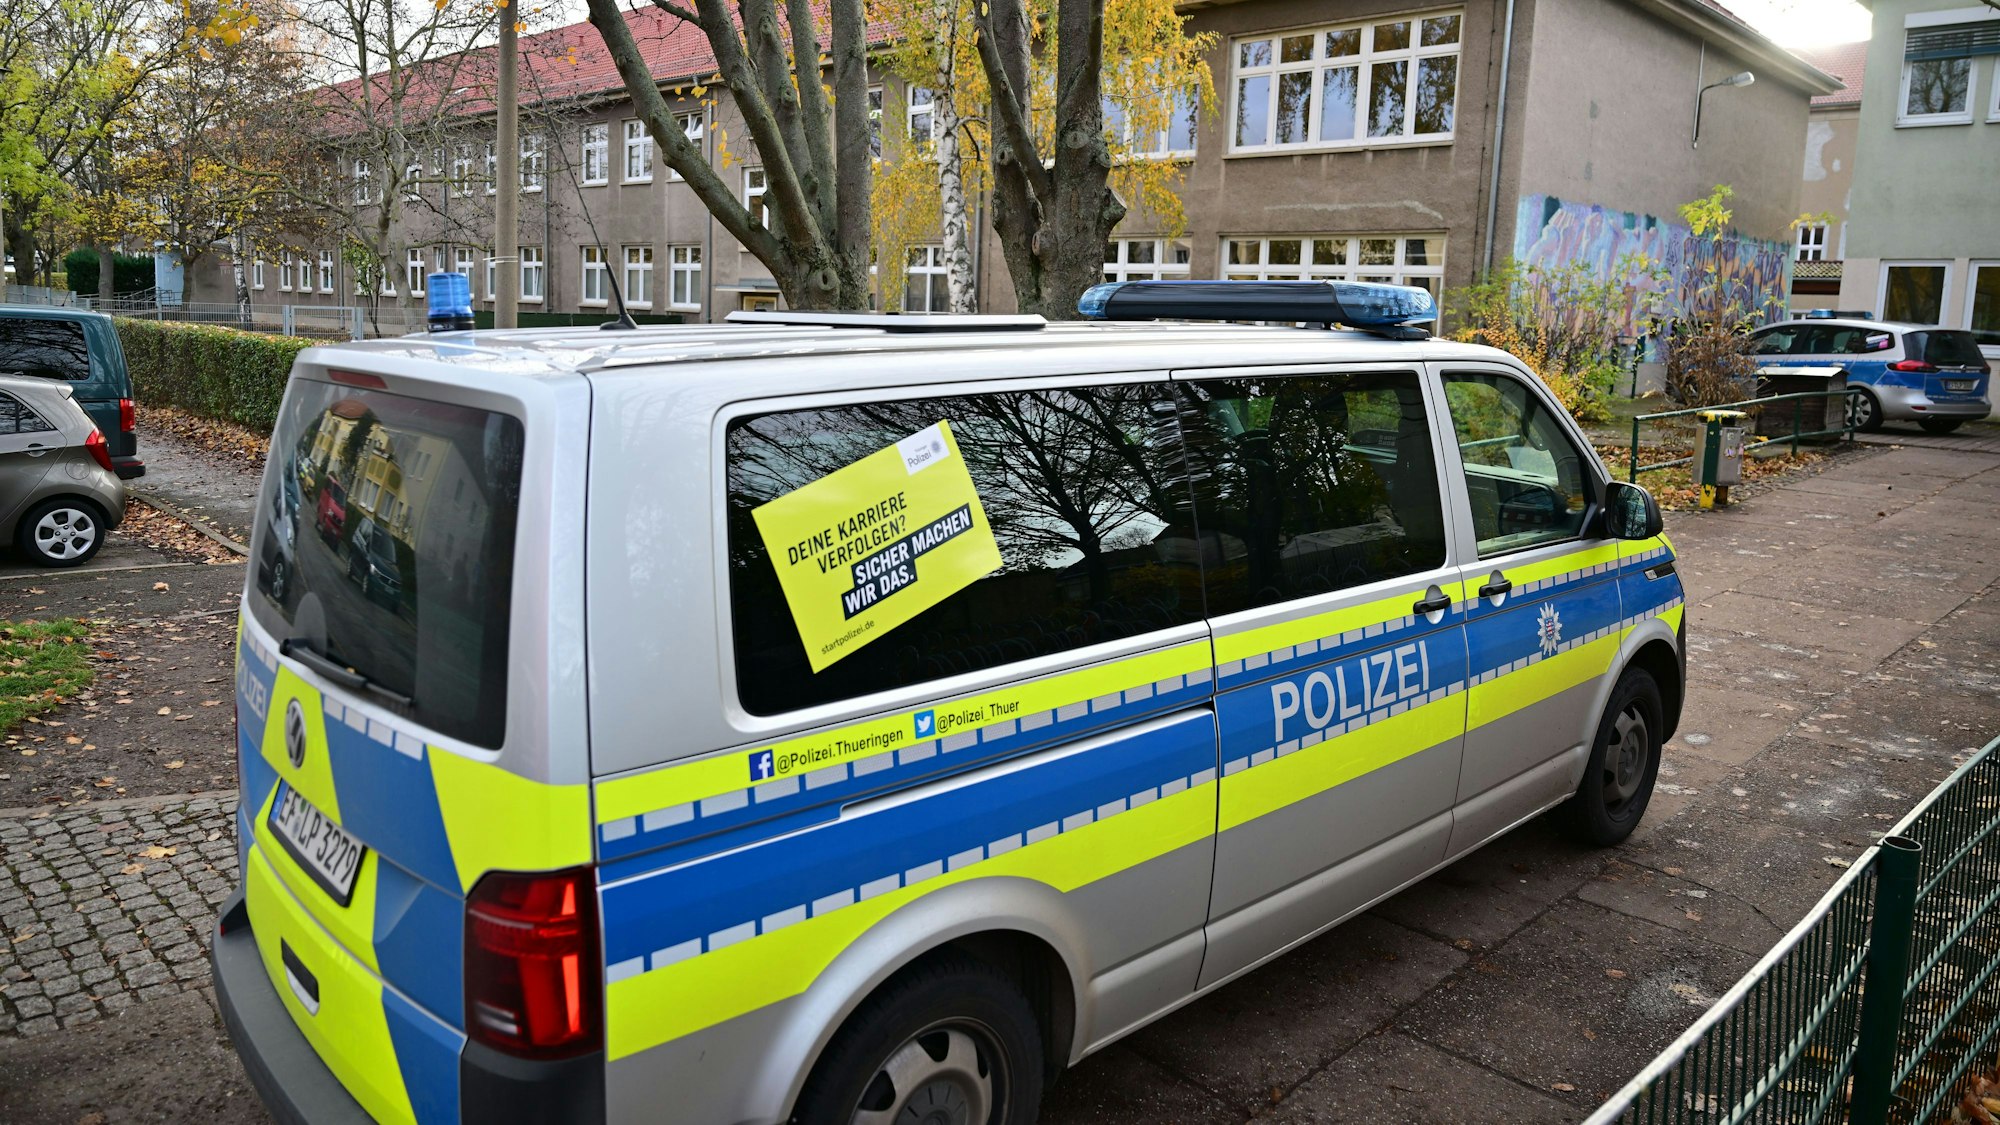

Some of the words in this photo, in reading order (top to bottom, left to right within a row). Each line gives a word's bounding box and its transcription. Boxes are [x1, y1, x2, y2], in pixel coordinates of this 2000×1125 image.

[907, 450, 932, 467] Polizei
[788, 528, 833, 566] DEINE
[838, 491, 908, 540] KARRIERE
[816, 514, 907, 574] VERFOLGEN?
[855, 543, 911, 585] SICHER
[911, 508, 971, 555] MACHEN
[844, 583, 878, 614] WIR
[879, 564, 915, 595] DAS.
[821, 620, 875, 655] startpolizei.de
[238, 655, 267, 722] OLIZEI
[937, 700, 1020, 733] @Polizei_Thuer
[1270, 640, 1430, 743] POLIZEI
[777, 728, 904, 774] @Polizei.Thueringen
[316, 820, 358, 884] 3279
